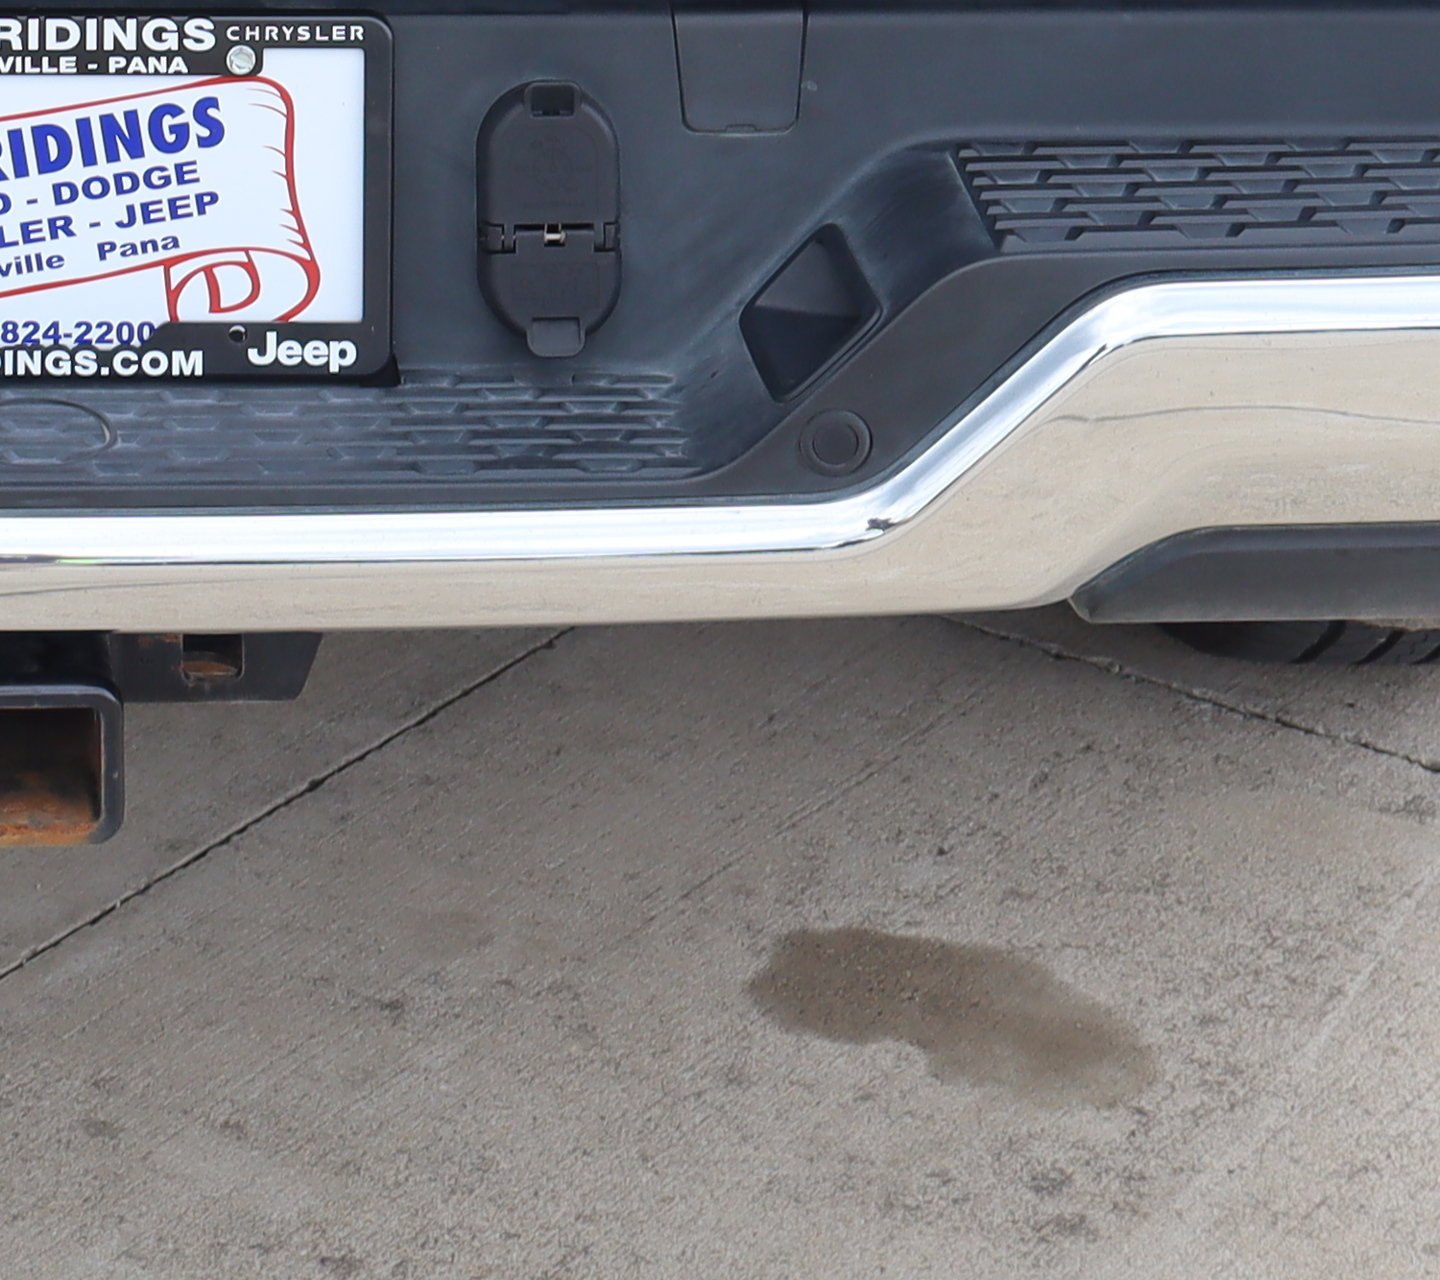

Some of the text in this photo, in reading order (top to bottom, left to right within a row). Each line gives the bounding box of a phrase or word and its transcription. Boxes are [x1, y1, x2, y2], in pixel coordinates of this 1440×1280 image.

[225, 24, 365, 41] CHRYSLER
[108, 54, 190, 75] PANA
[51, 160, 201, 207] DODGE
[114, 191, 220, 230] JEEP
[96, 236, 181, 263] Pana
[246, 331, 358, 374] Jeep
